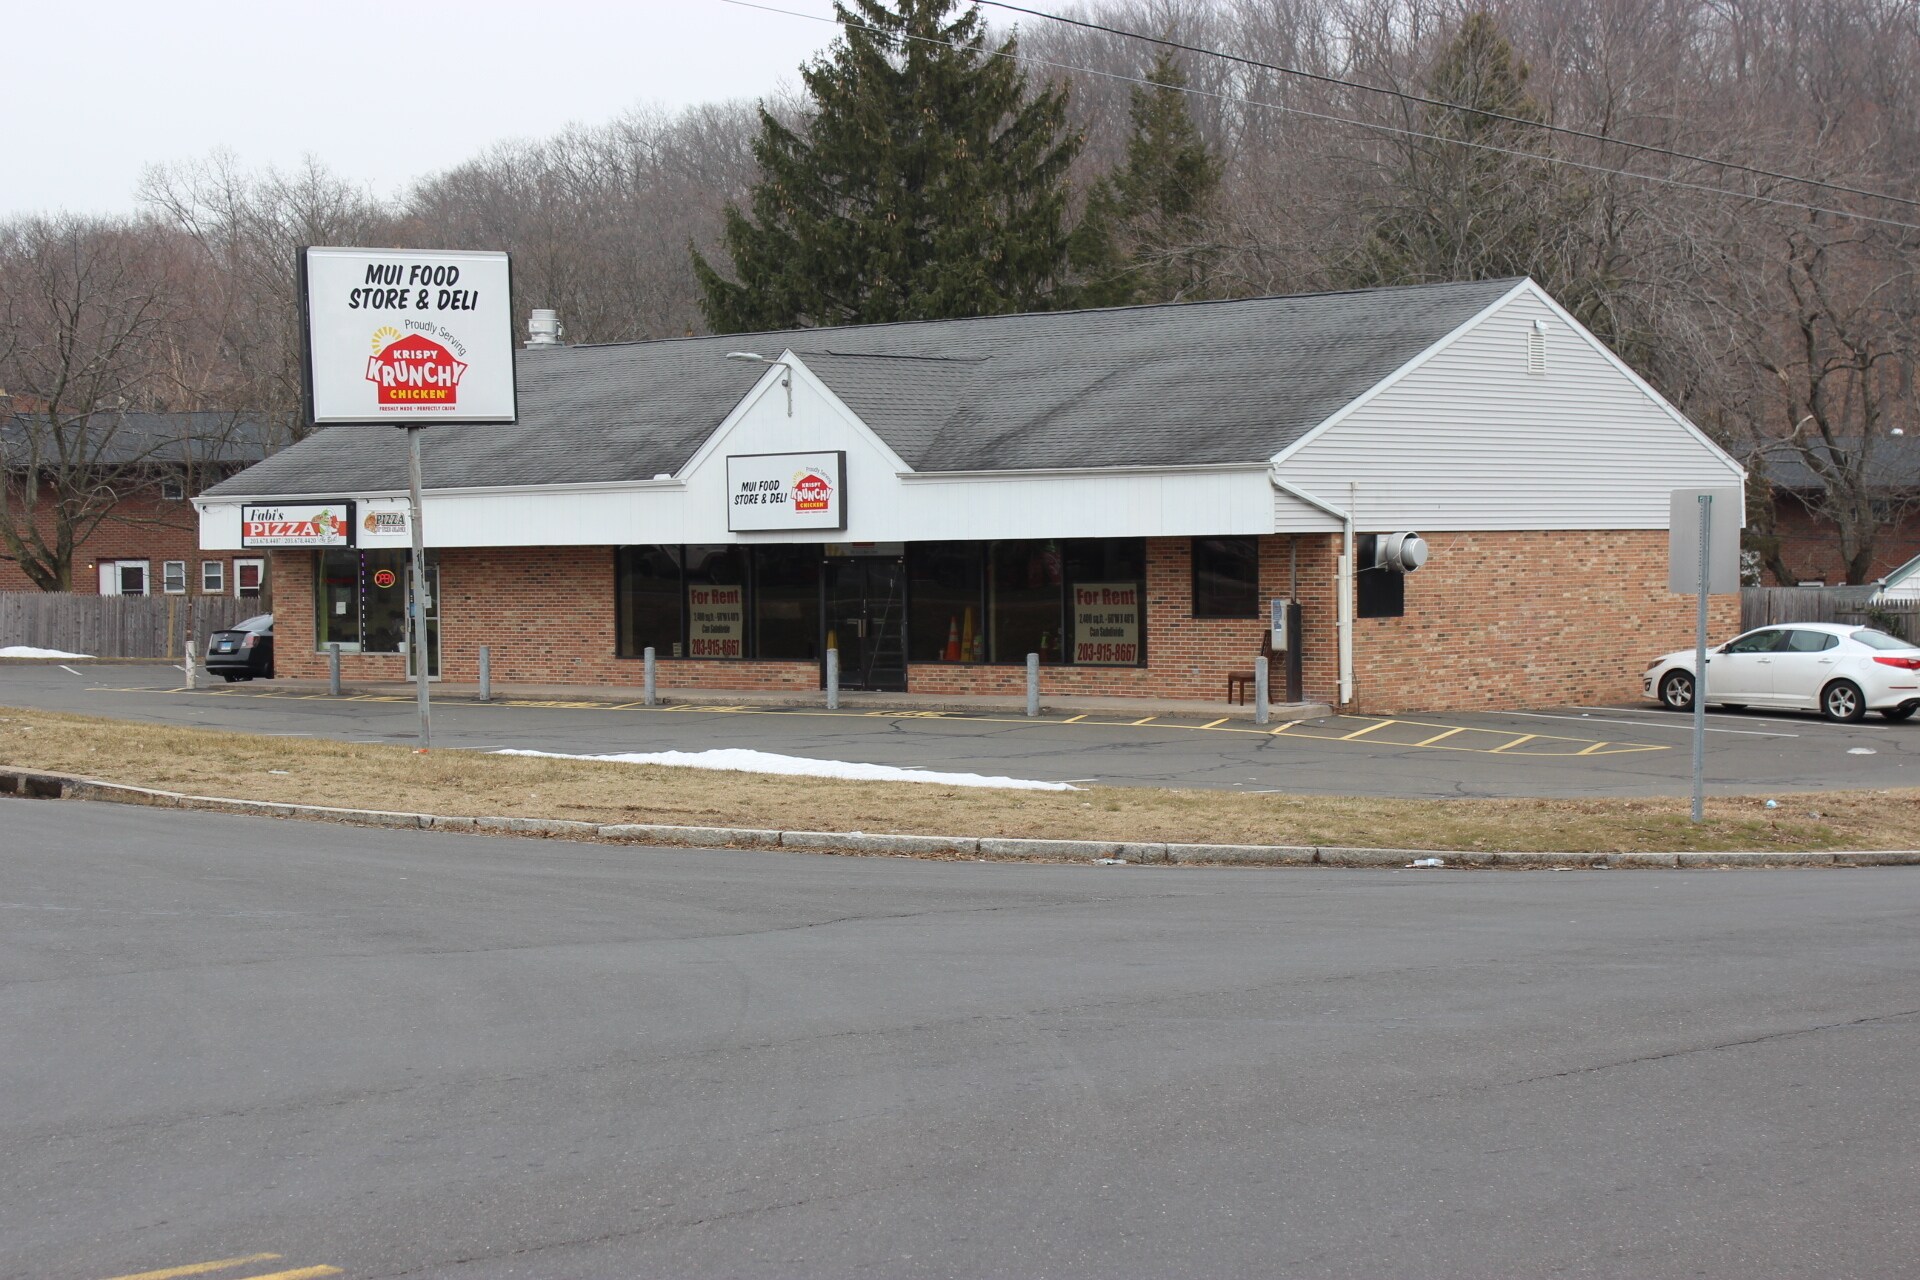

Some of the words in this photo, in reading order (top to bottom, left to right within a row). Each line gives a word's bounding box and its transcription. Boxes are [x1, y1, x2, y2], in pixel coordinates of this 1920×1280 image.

[365, 264, 403, 286] MUI
[409, 265, 459, 287] FOOD
[348, 288, 410, 310] STORE
[415, 289, 429, 310] &
[437, 290, 478, 311] DELI
[404, 319, 437, 335] Proudly
[438, 327, 467, 357] Serving
[393, 350, 438, 359] KRISPY
[367, 358, 466, 387] KRUNCHY
[390, 389, 446, 399] CHICKEN
[741, 482, 757, 492] MUI
[759, 480, 780, 492] FOOD
[734, 493, 759, 505] STORE
[761, 493, 767, 504] &
[769, 493, 788, 504] DELI
[791, 487, 833, 502] KRUNCHY
[250, 508, 284, 521] Fabi's
[376, 514, 405, 525] PIZZA
[250, 522, 317, 536] PIZZA
[376, 573, 394, 584] OPEN
[691, 589, 709, 604] For
[712, 588, 739, 604] Rent
[1077, 588, 1099, 605] For
[1102, 588, 1136, 605] Rent
[692, 639, 739, 656] 203-915-8667
[1077, 643, 1136, 662] 203-915-8667
